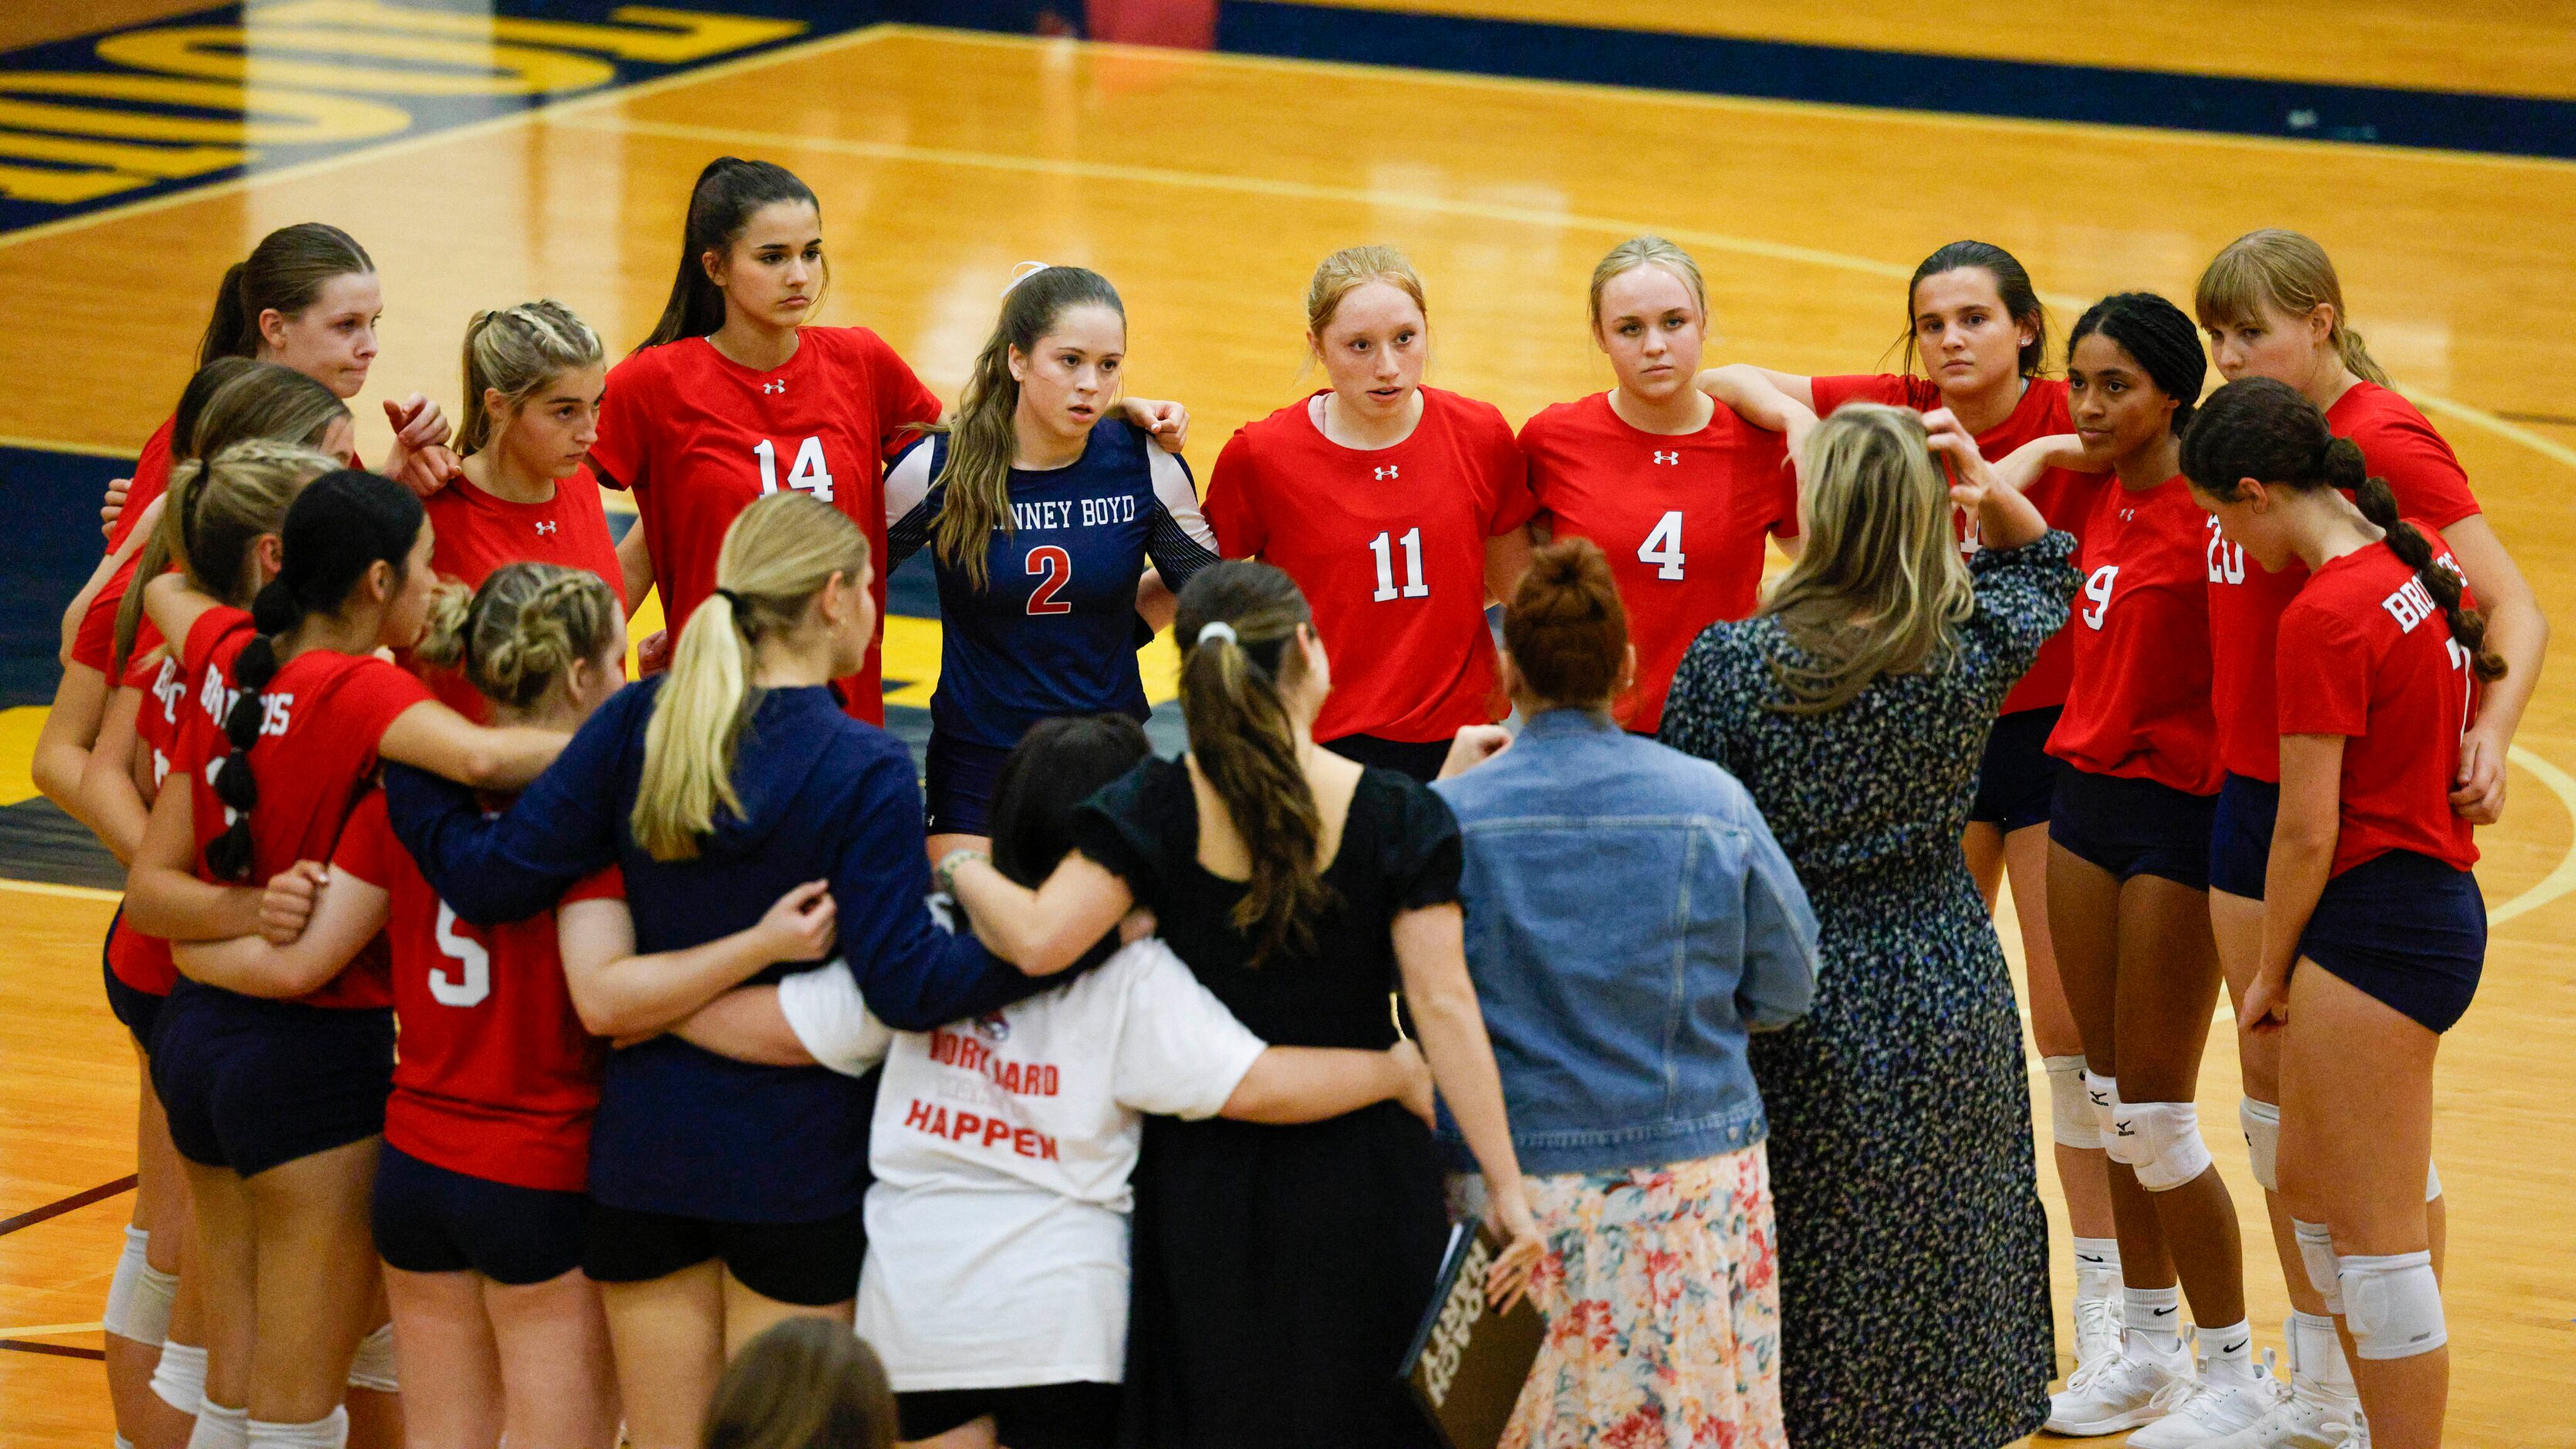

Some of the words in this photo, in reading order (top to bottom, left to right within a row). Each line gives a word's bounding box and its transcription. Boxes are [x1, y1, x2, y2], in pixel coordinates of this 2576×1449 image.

[753, 436, 834, 503] 14
[1081, 495, 1136, 527] BOYD
[1637, 510, 1686, 581] 4
[1025, 545, 1072, 616] 2
[1369, 527, 1430, 603] 11
[2206, 514, 2245, 585] 20
[2083, 565, 2119, 631] 9
[428, 898, 490, 1008] 5
[904, 1099, 1059, 1163] HAPPEN
